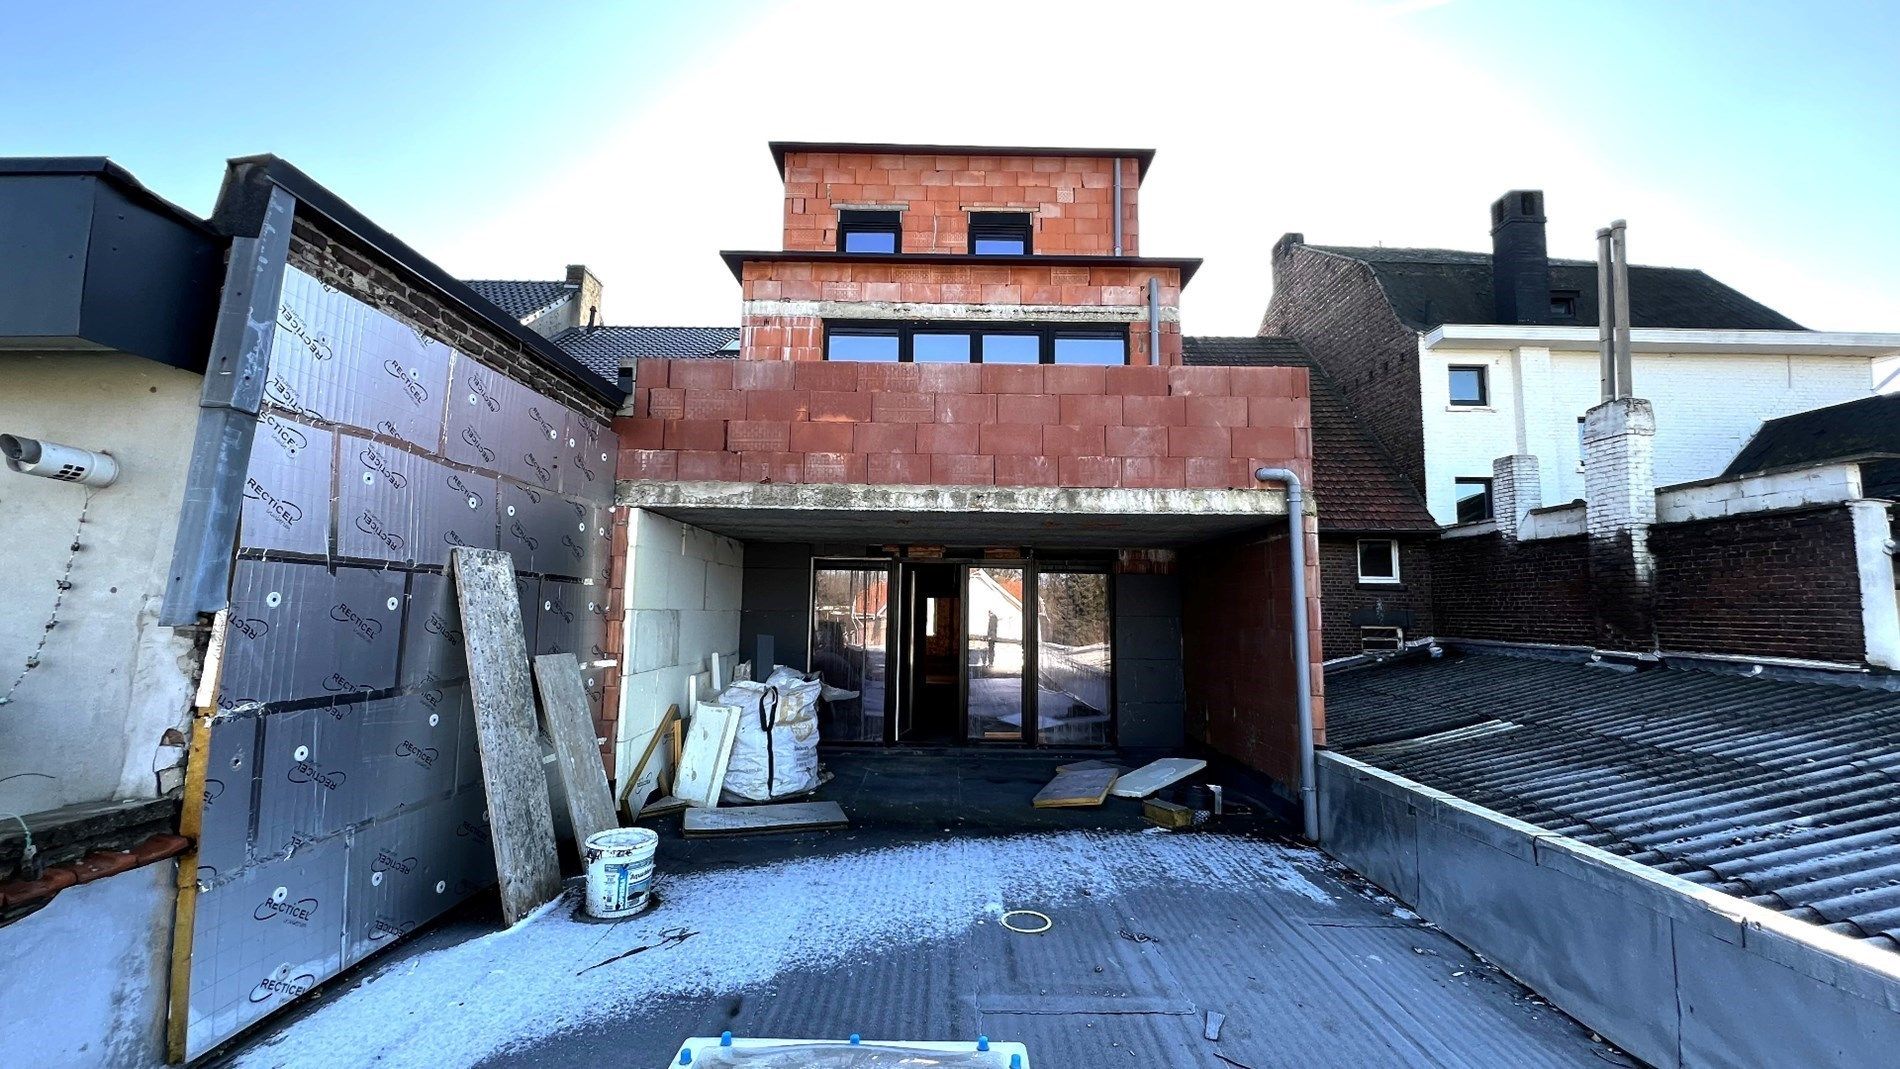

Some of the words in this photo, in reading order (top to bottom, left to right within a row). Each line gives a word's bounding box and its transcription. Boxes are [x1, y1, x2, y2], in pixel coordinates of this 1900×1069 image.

[281, 305, 323, 360] RECTICEL
[274, 378, 304, 414] CTICEL
[391, 360, 422, 404] RECTICEL
[368, 447, 400, 489] RECTICEL
[247, 478, 294, 526] RECTICEL
[363, 512, 397, 551] RECTICEL
[227, 612, 258, 640] RECTI
[339, 603, 376, 640] RECTICEL
[402, 740, 433, 766] RECTICEL
[297, 762, 338, 790] RECTICEL
[378, 852, 411, 875] RECTICEL
[264, 897, 310, 921] RECTICEL
[375, 920, 405, 938] ECTICEL
